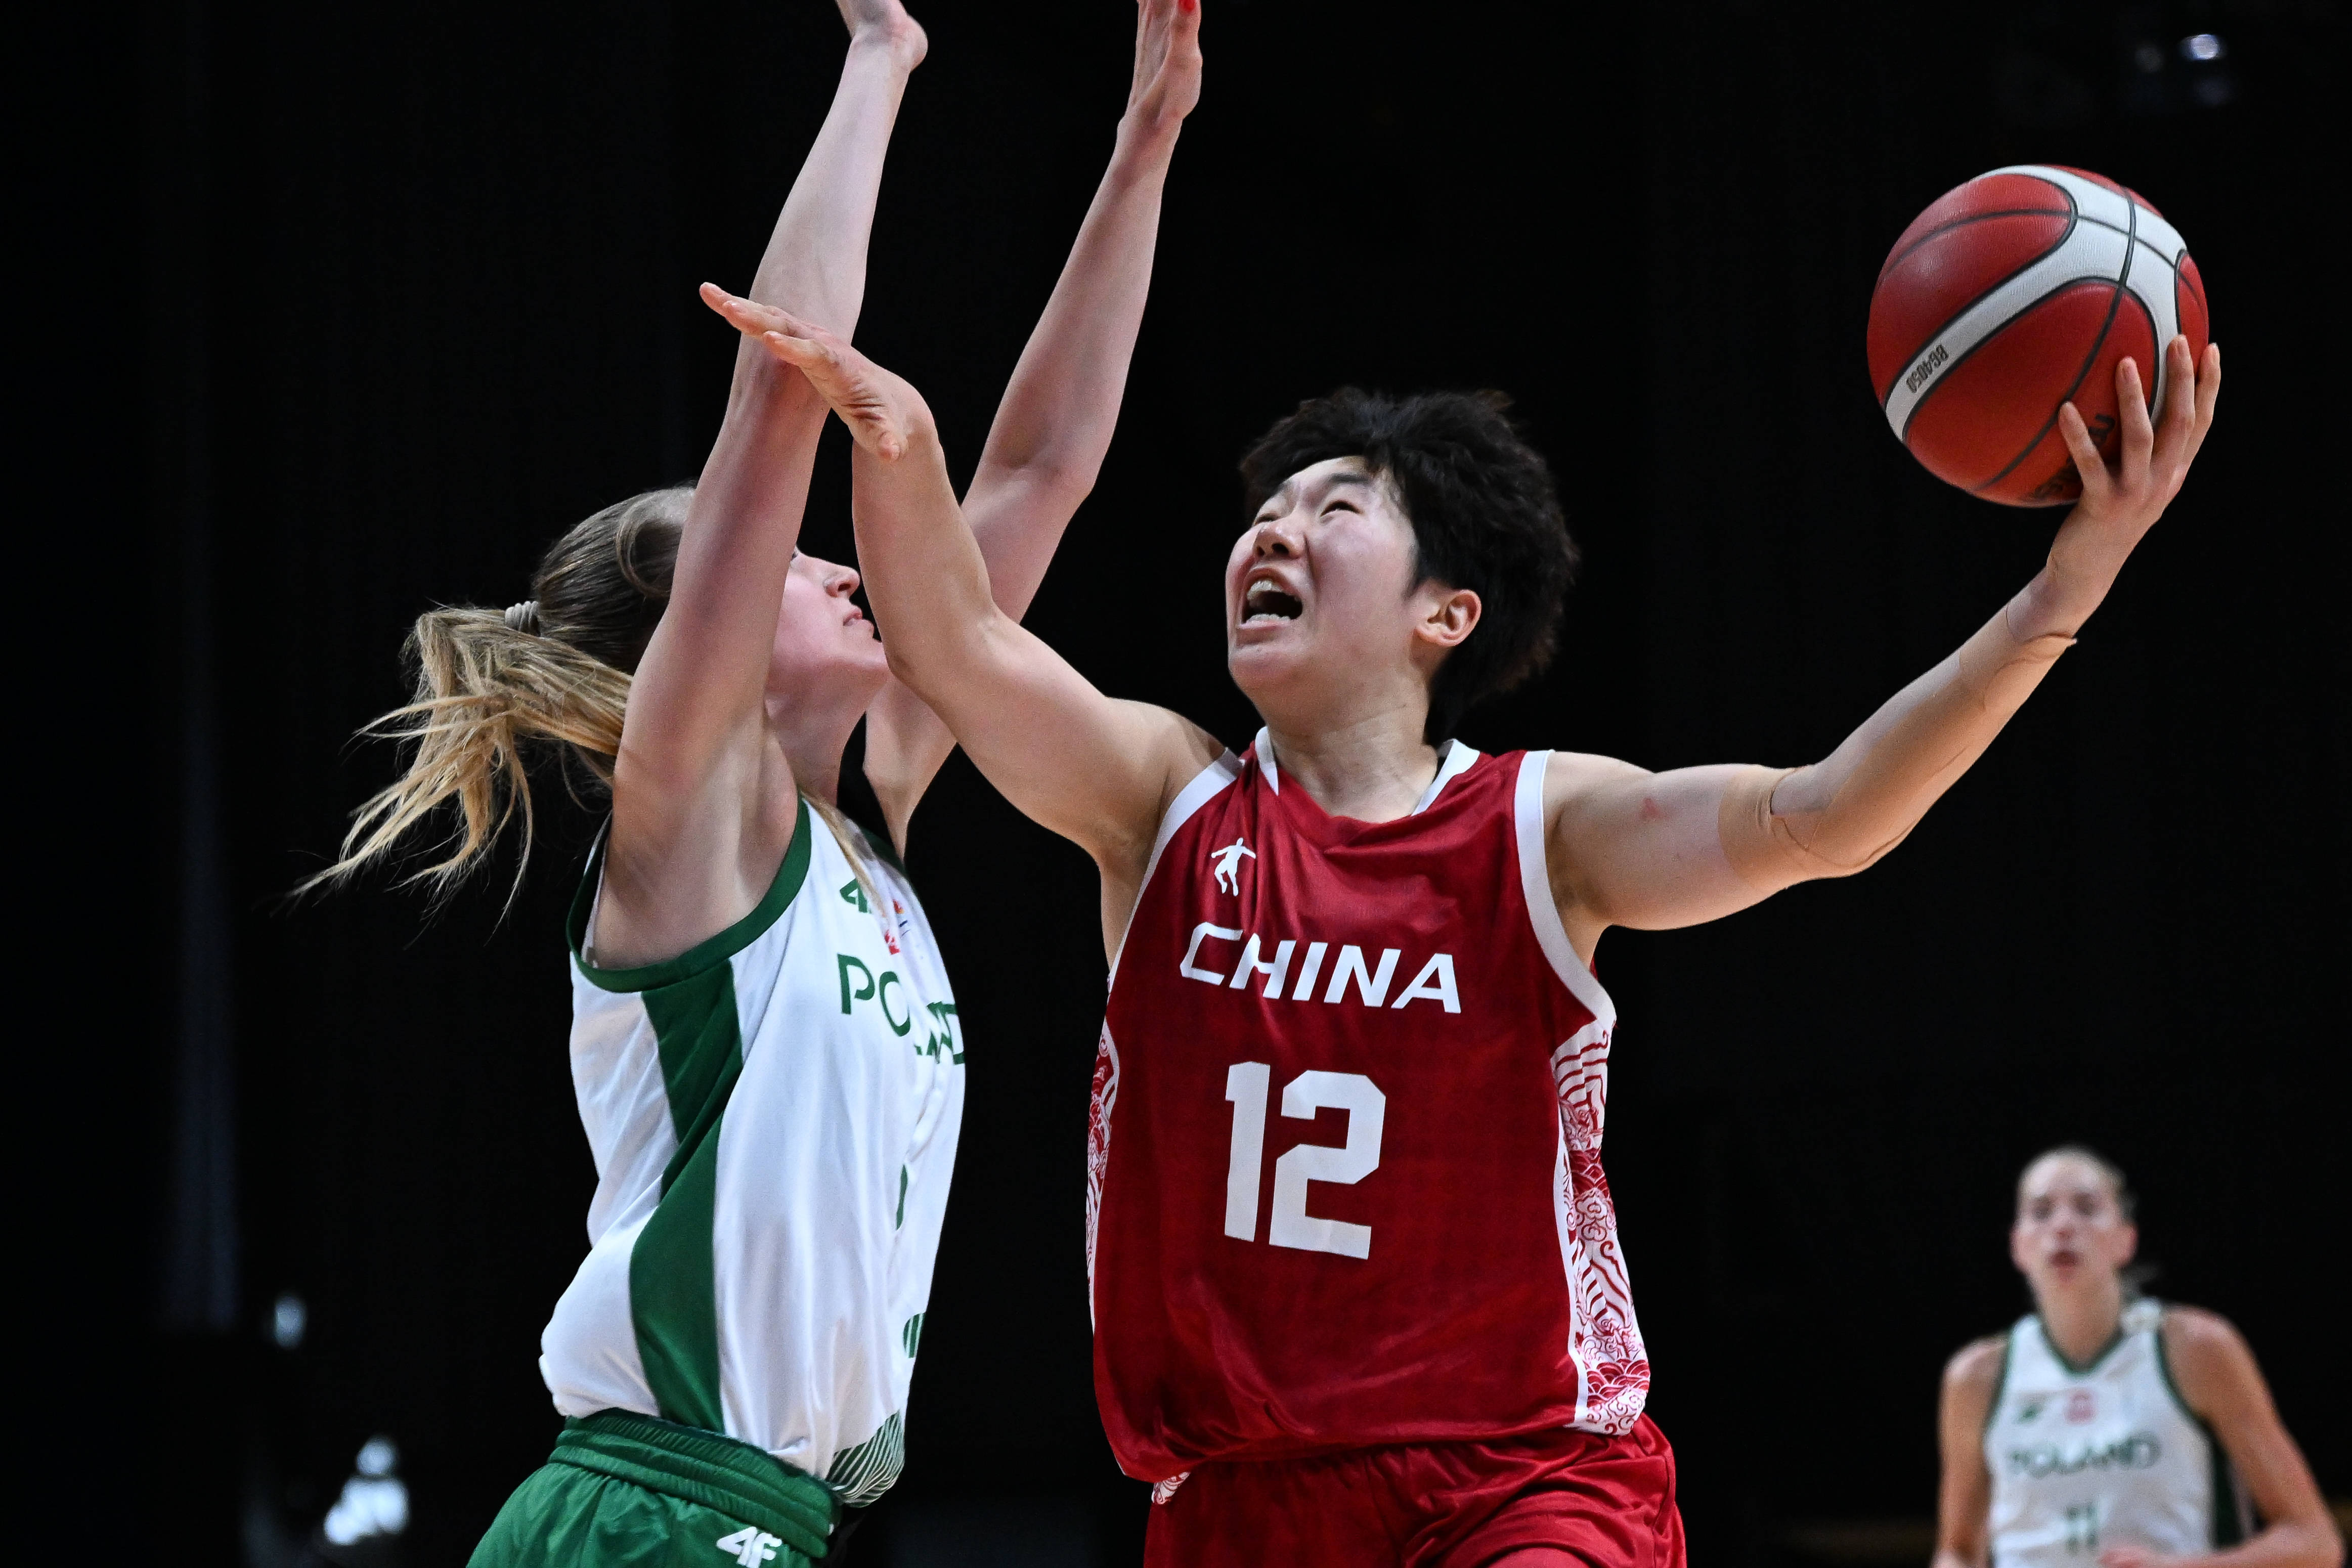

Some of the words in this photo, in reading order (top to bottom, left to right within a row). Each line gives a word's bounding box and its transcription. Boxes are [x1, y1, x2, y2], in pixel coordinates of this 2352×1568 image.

[1181, 922, 1461, 1014] CHINA
[1225, 1061, 1386, 1259] 12
[717, 1527, 782, 1568] 4F
